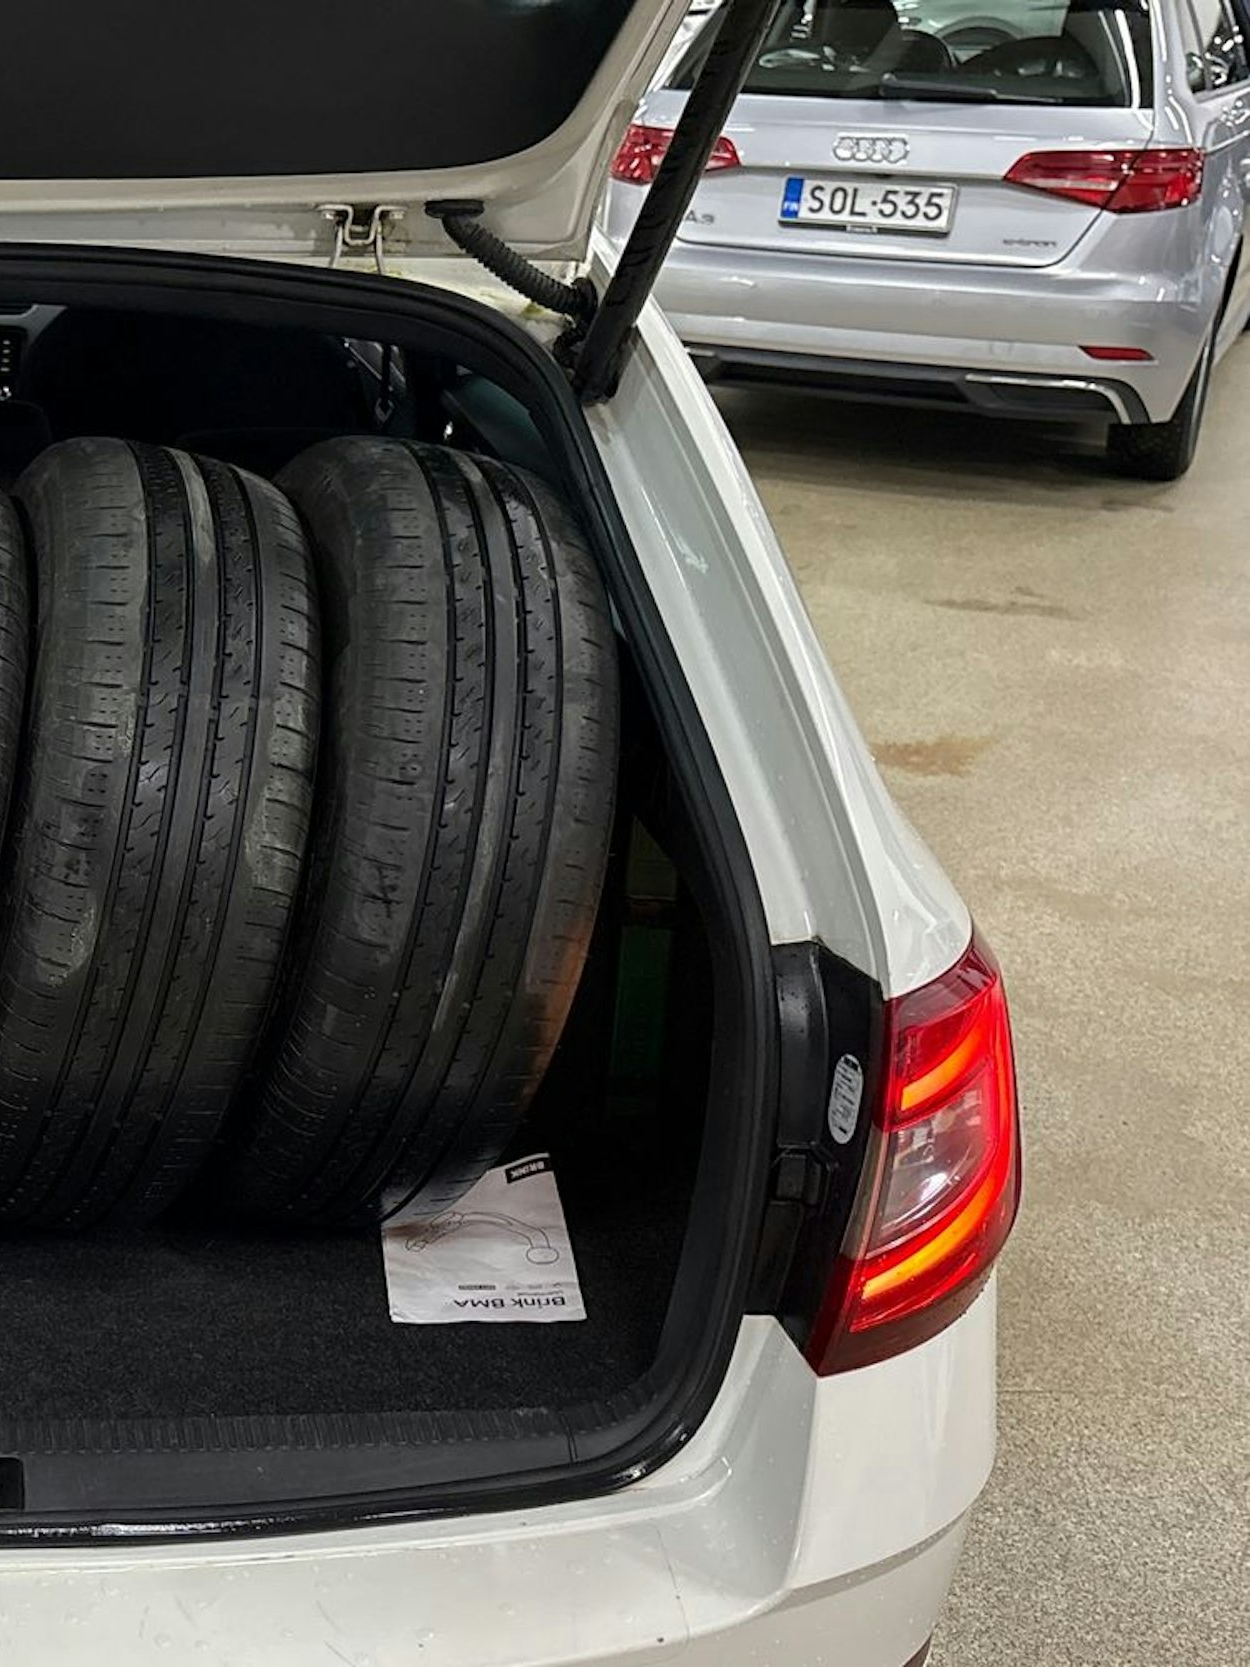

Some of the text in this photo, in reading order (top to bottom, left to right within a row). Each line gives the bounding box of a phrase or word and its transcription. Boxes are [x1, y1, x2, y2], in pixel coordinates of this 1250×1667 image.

[808, 185, 945, 221] SOL-535
[454, 1296, 566, 1309] Brink BMA
